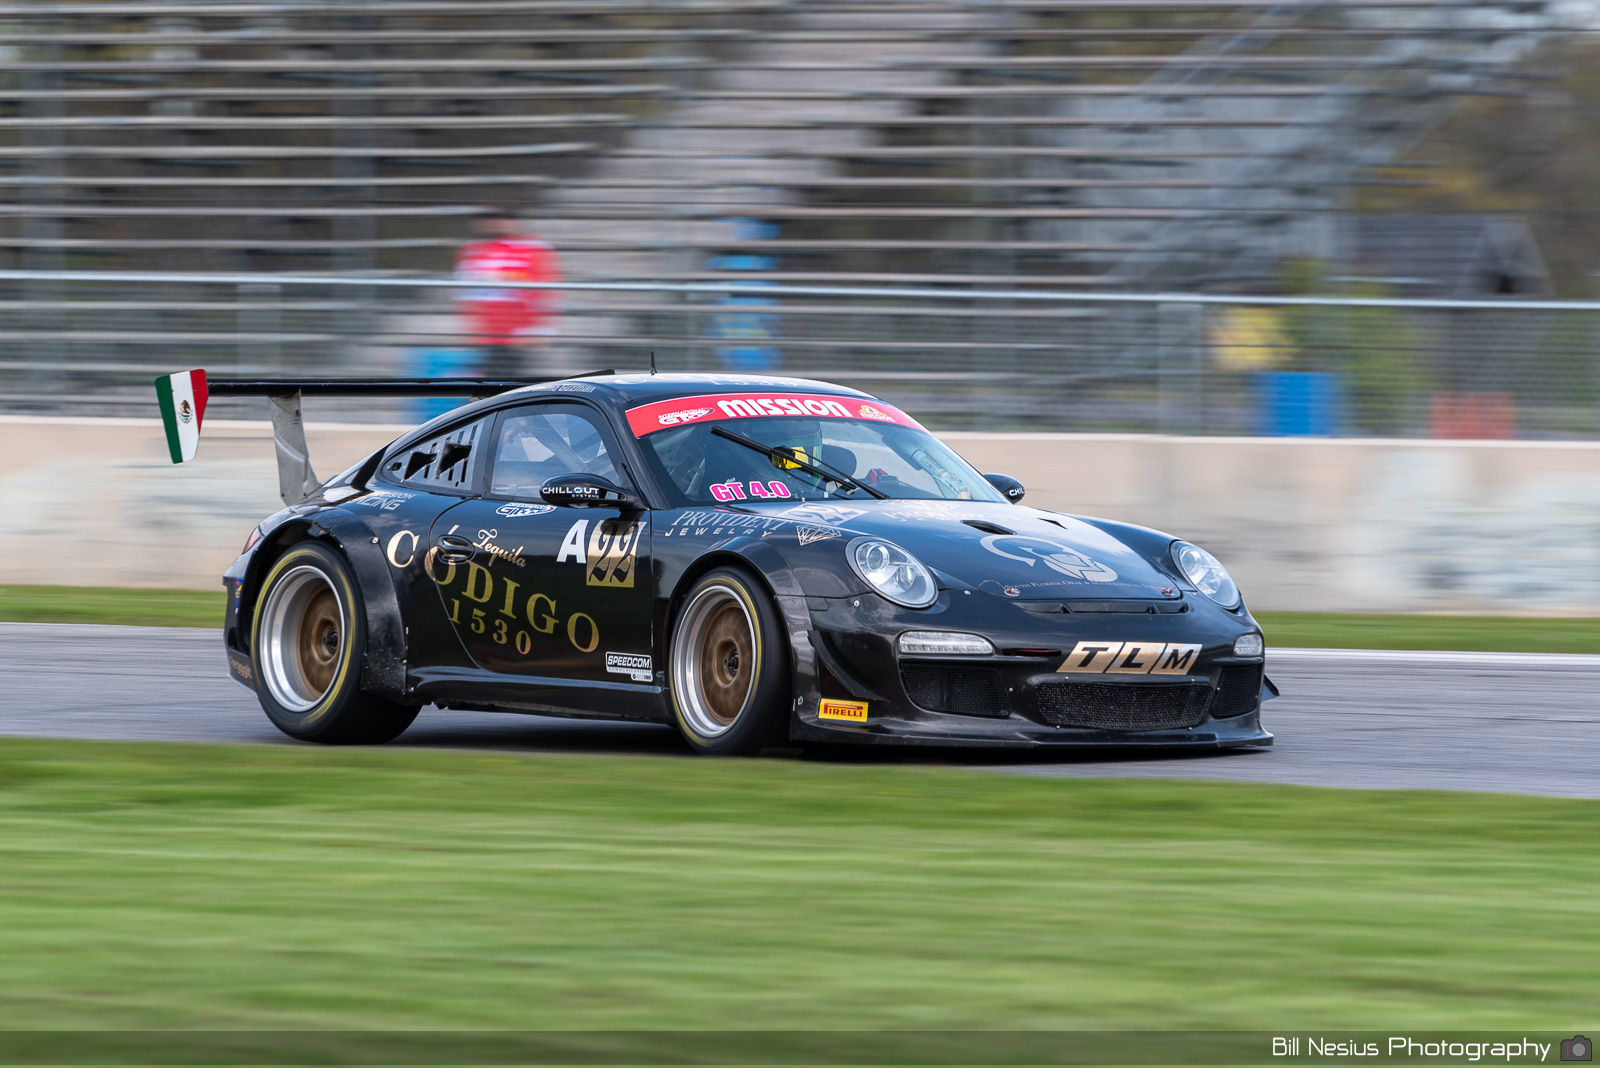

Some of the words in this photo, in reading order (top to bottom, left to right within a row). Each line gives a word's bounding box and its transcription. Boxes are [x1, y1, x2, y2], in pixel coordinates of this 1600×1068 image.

[717, 399, 853, 417] MISSION
[542, 487, 599, 495] CHILLOUT
[709, 482, 747, 502] GT
[749, 480, 791, 498] 4.0
[671, 511, 793, 530] PROVIDENT
[665, 528, 773, 537] JEWELRY
[472, 529, 526, 567] Tequila
[449, 598, 532, 655] 1530
[607, 655, 650, 669] SPEEDCOM
[1077, 646, 1195, 670] TLM
[823, 702, 863, 717] PIRELLI
